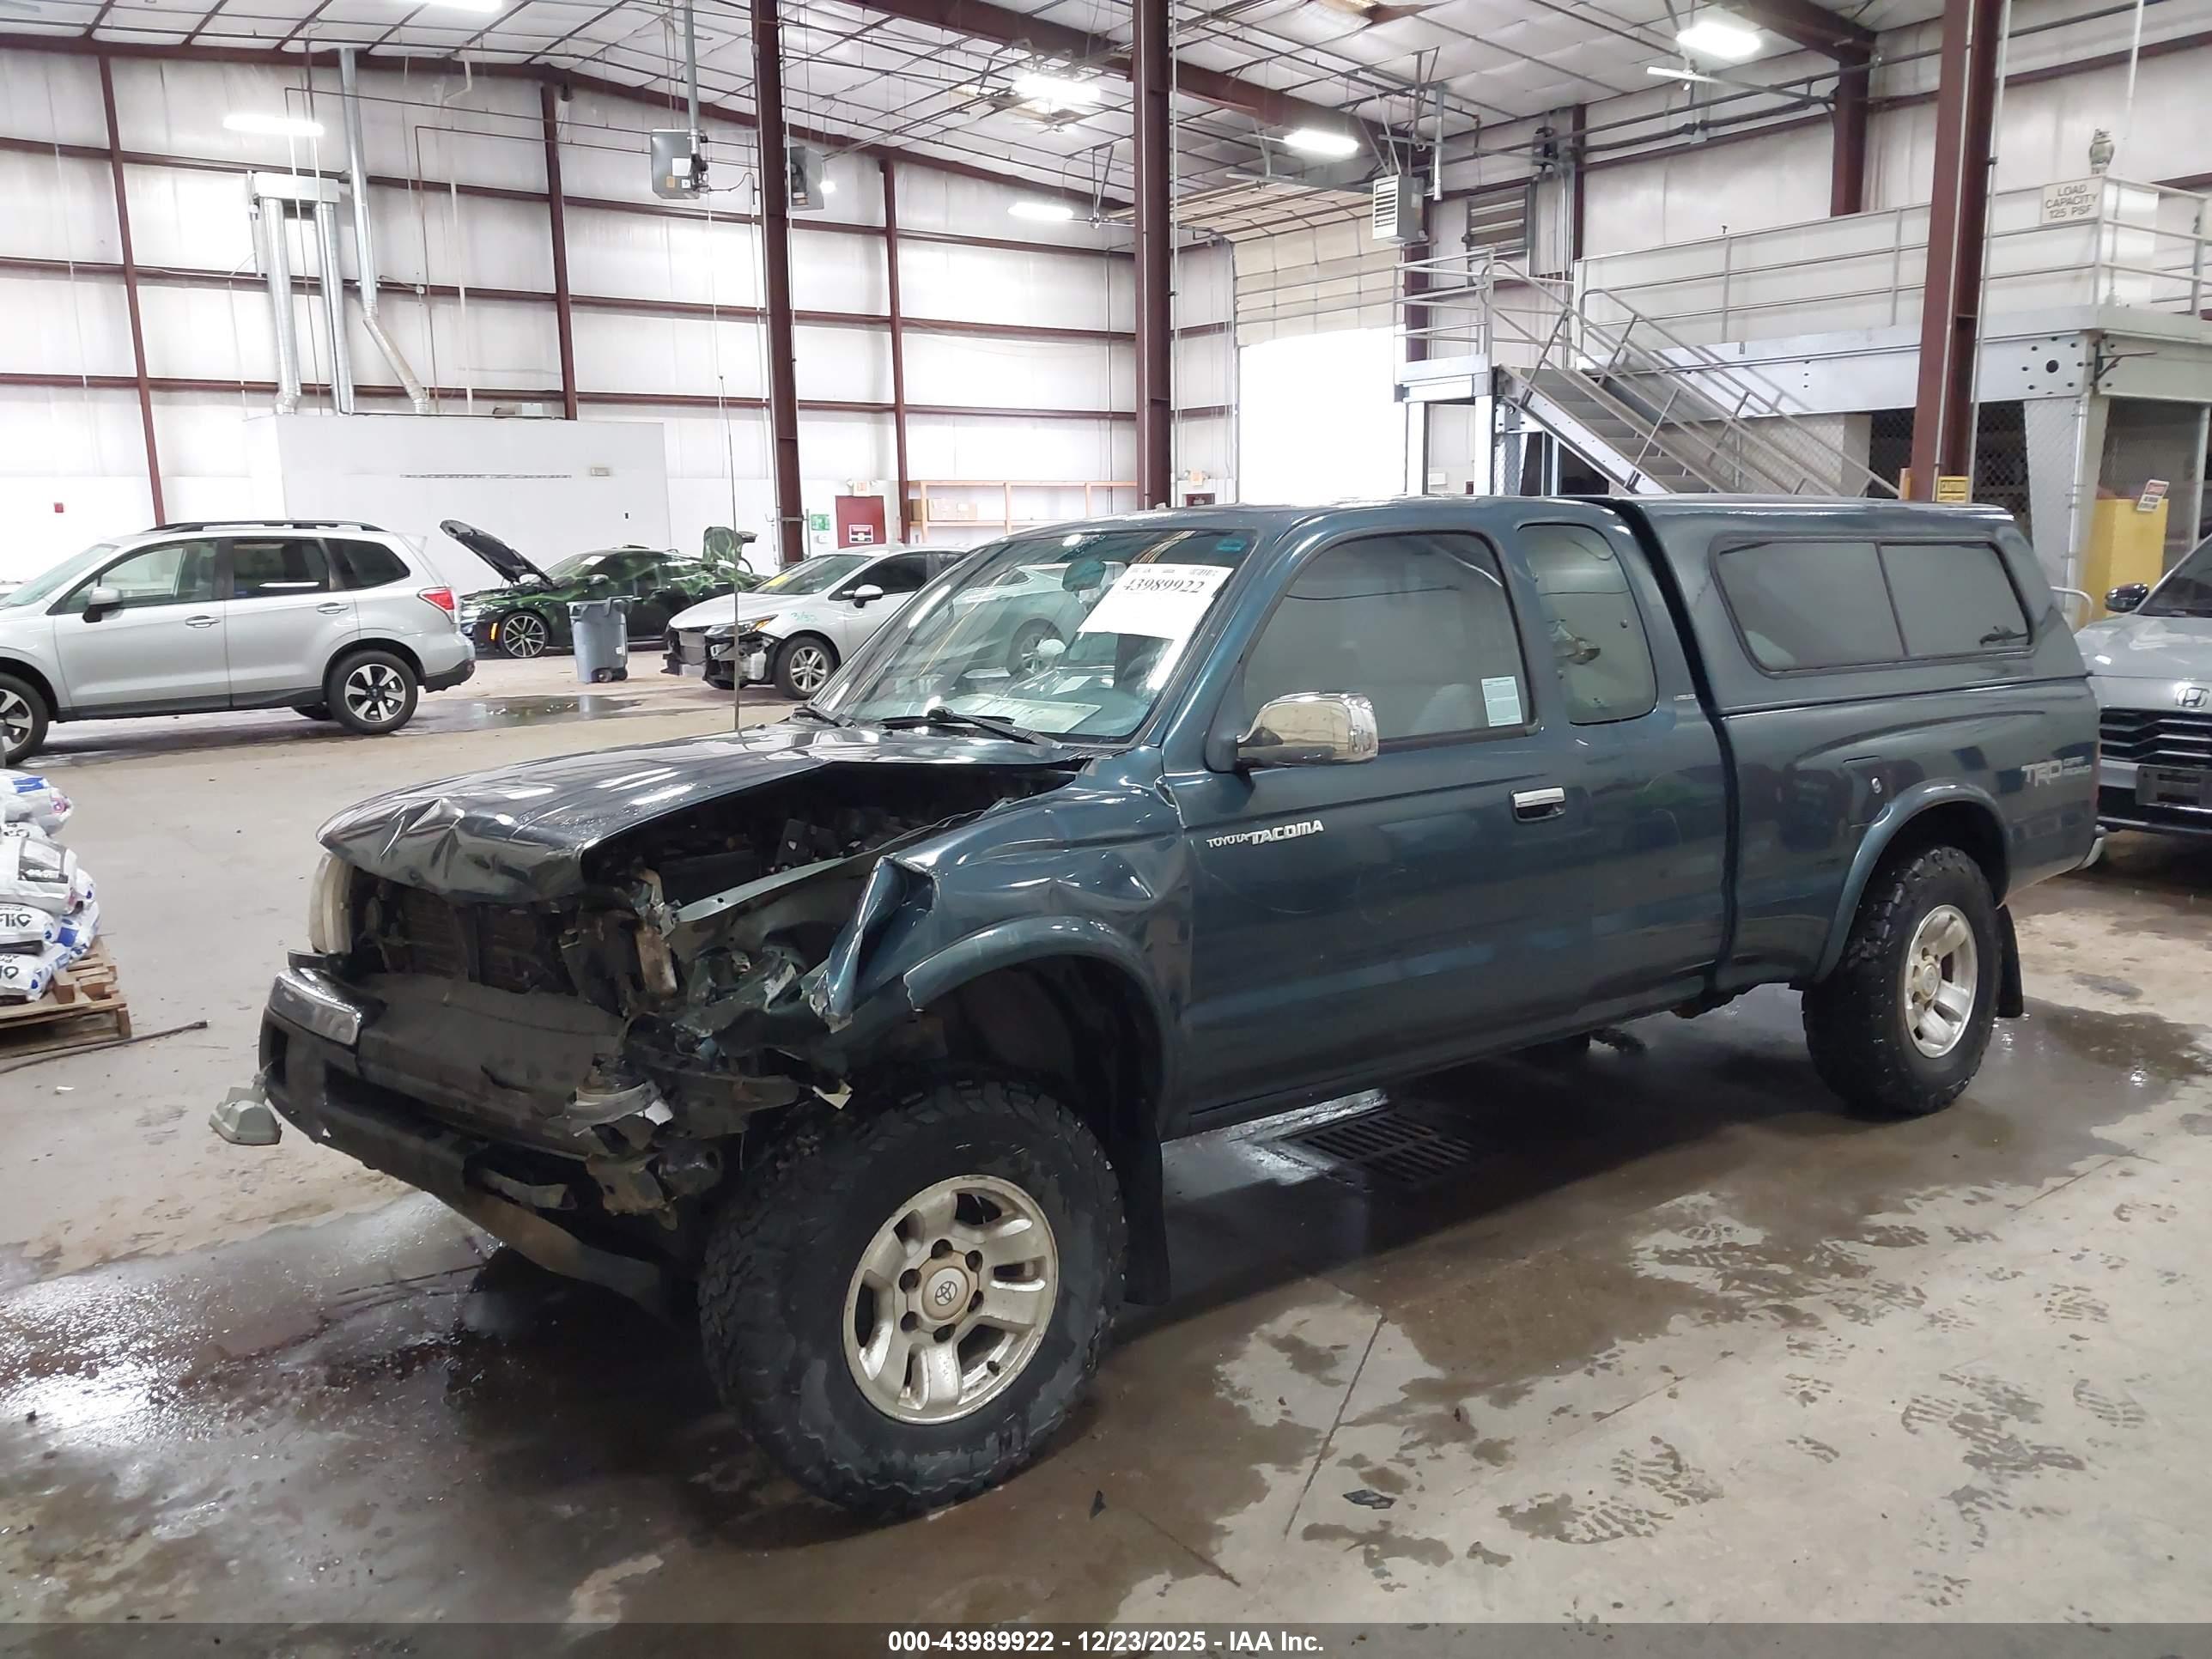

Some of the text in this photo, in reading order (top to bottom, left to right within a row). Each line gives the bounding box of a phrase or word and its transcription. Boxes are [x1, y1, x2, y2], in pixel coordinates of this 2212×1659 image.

[2057, 185, 2087, 197] LOAD
[2045, 193, 2098, 209] CAPACITY
[2050, 208, 2067, 218] 125
[1123, 578, 1205, 593] 43989922
[2021, 760, 2062, 787] TRD
[1206, 819, 1325, 848] TOYOTA TACOMA
